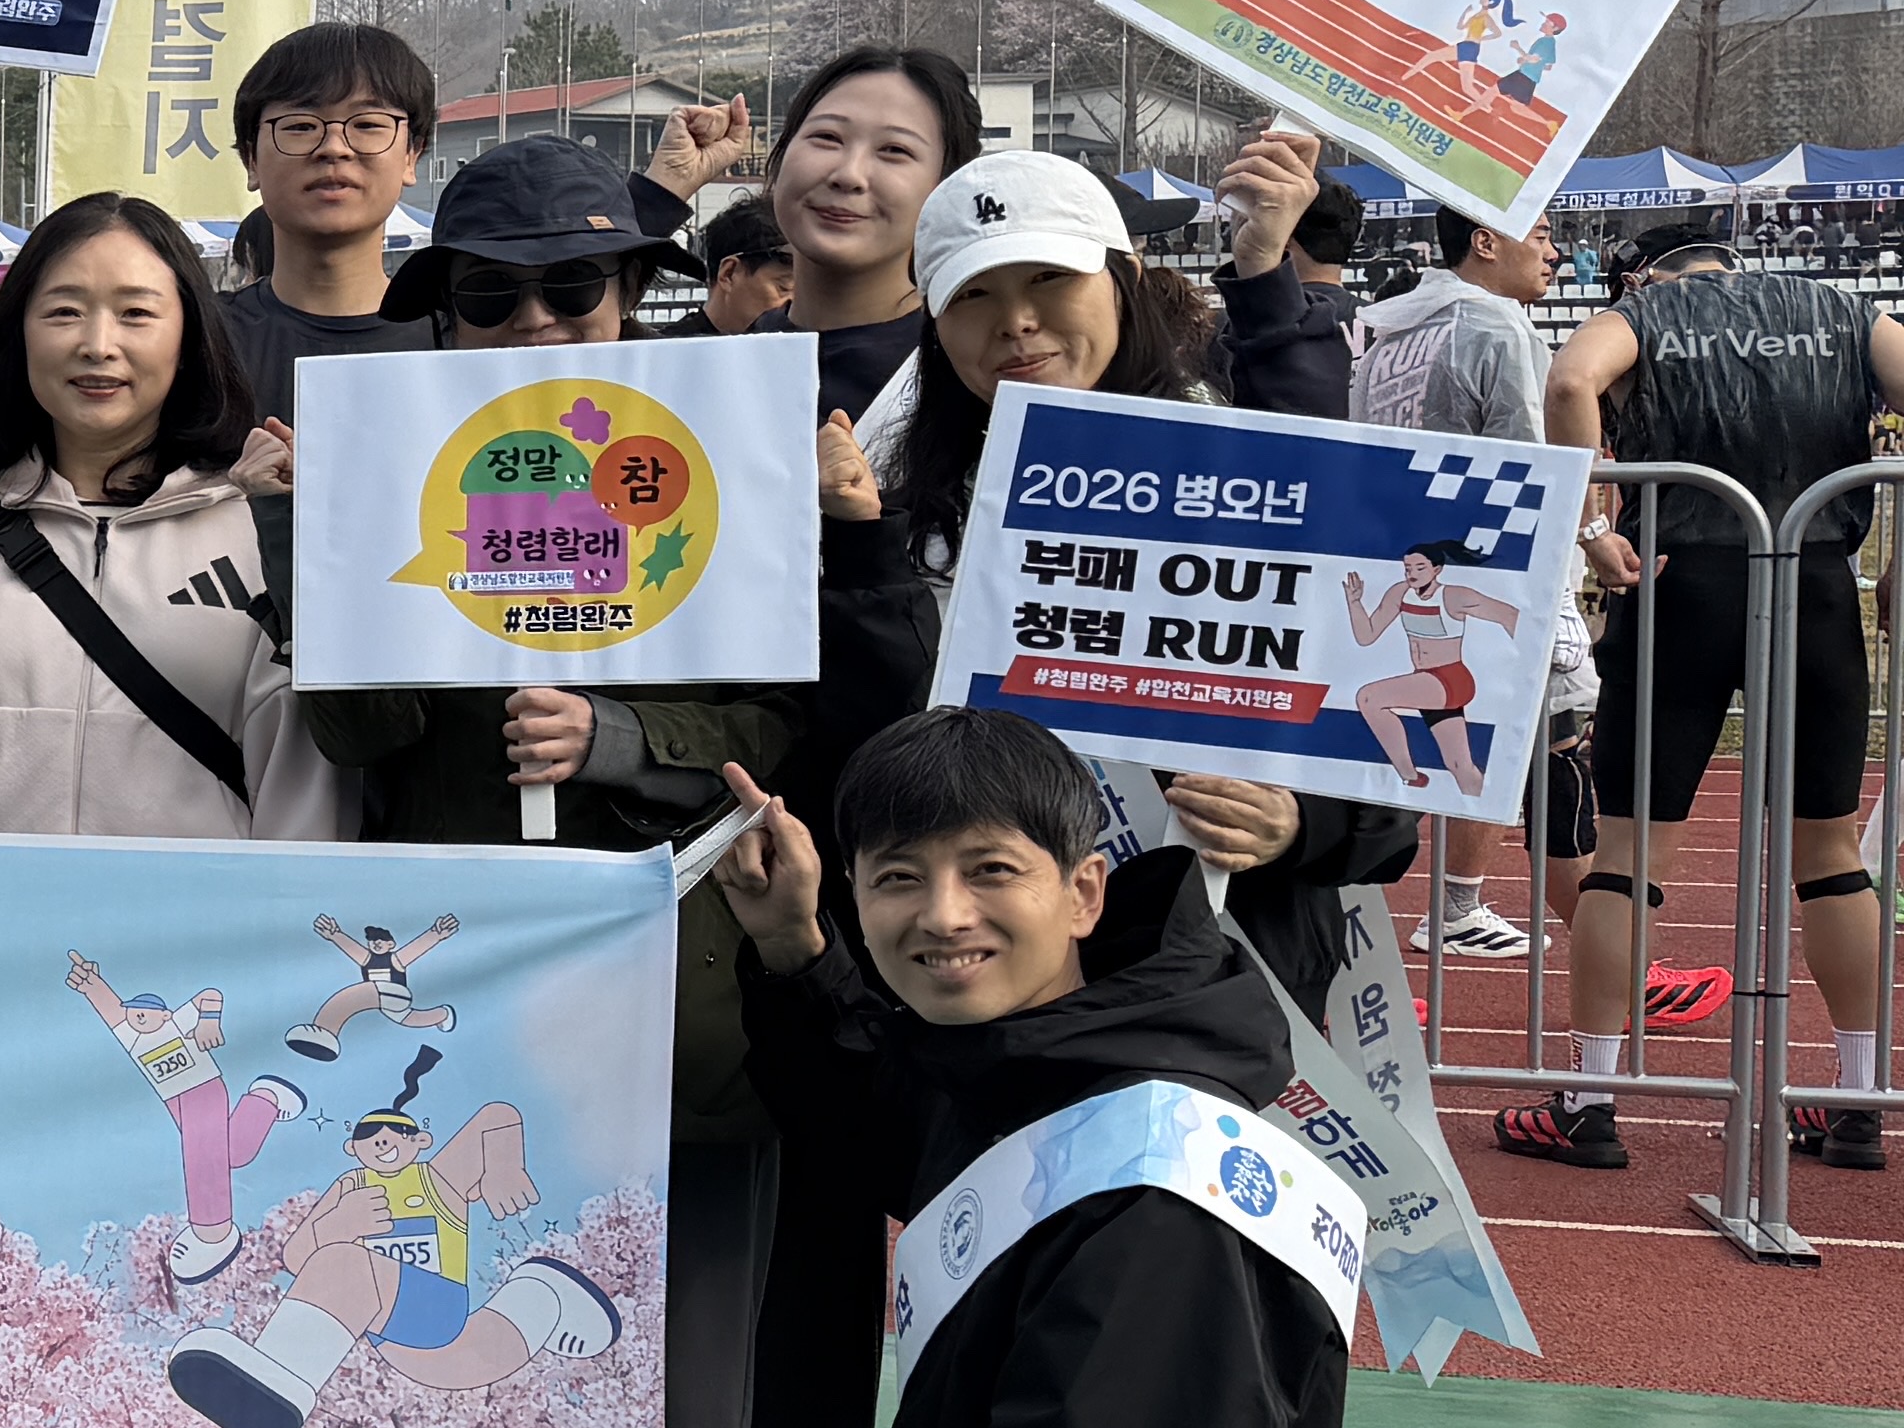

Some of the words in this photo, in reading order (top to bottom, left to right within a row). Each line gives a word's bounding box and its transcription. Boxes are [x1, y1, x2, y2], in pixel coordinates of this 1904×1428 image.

[973, 192, 1007, 224] LA
[1656, 328, 1719, 361] Air
[1725, 326, 1835, 358] Vent
[487, 444, 562, 484] 정말
[619, 456, 668, 506] 참
[1018, 464, 1161, 515] 2026
[1174, 474, 1308, 526] 병오년
[482, 527, 620, 565] 청렴할래
[1020, 539, 1138, 593] 부패
[1158, 552, 1313, 607] OUT
[504, 604, 633, 633] #청렴완주
[1013, 601, 1126, 657] 청렴
[1143, 616, 1304, 672] RUN
[1033, 667, 1128, 693] #청렴완주
[1135, 678, 1293, 711] #합천교육지원청
[152, 1052, 188, 1078] 3250
